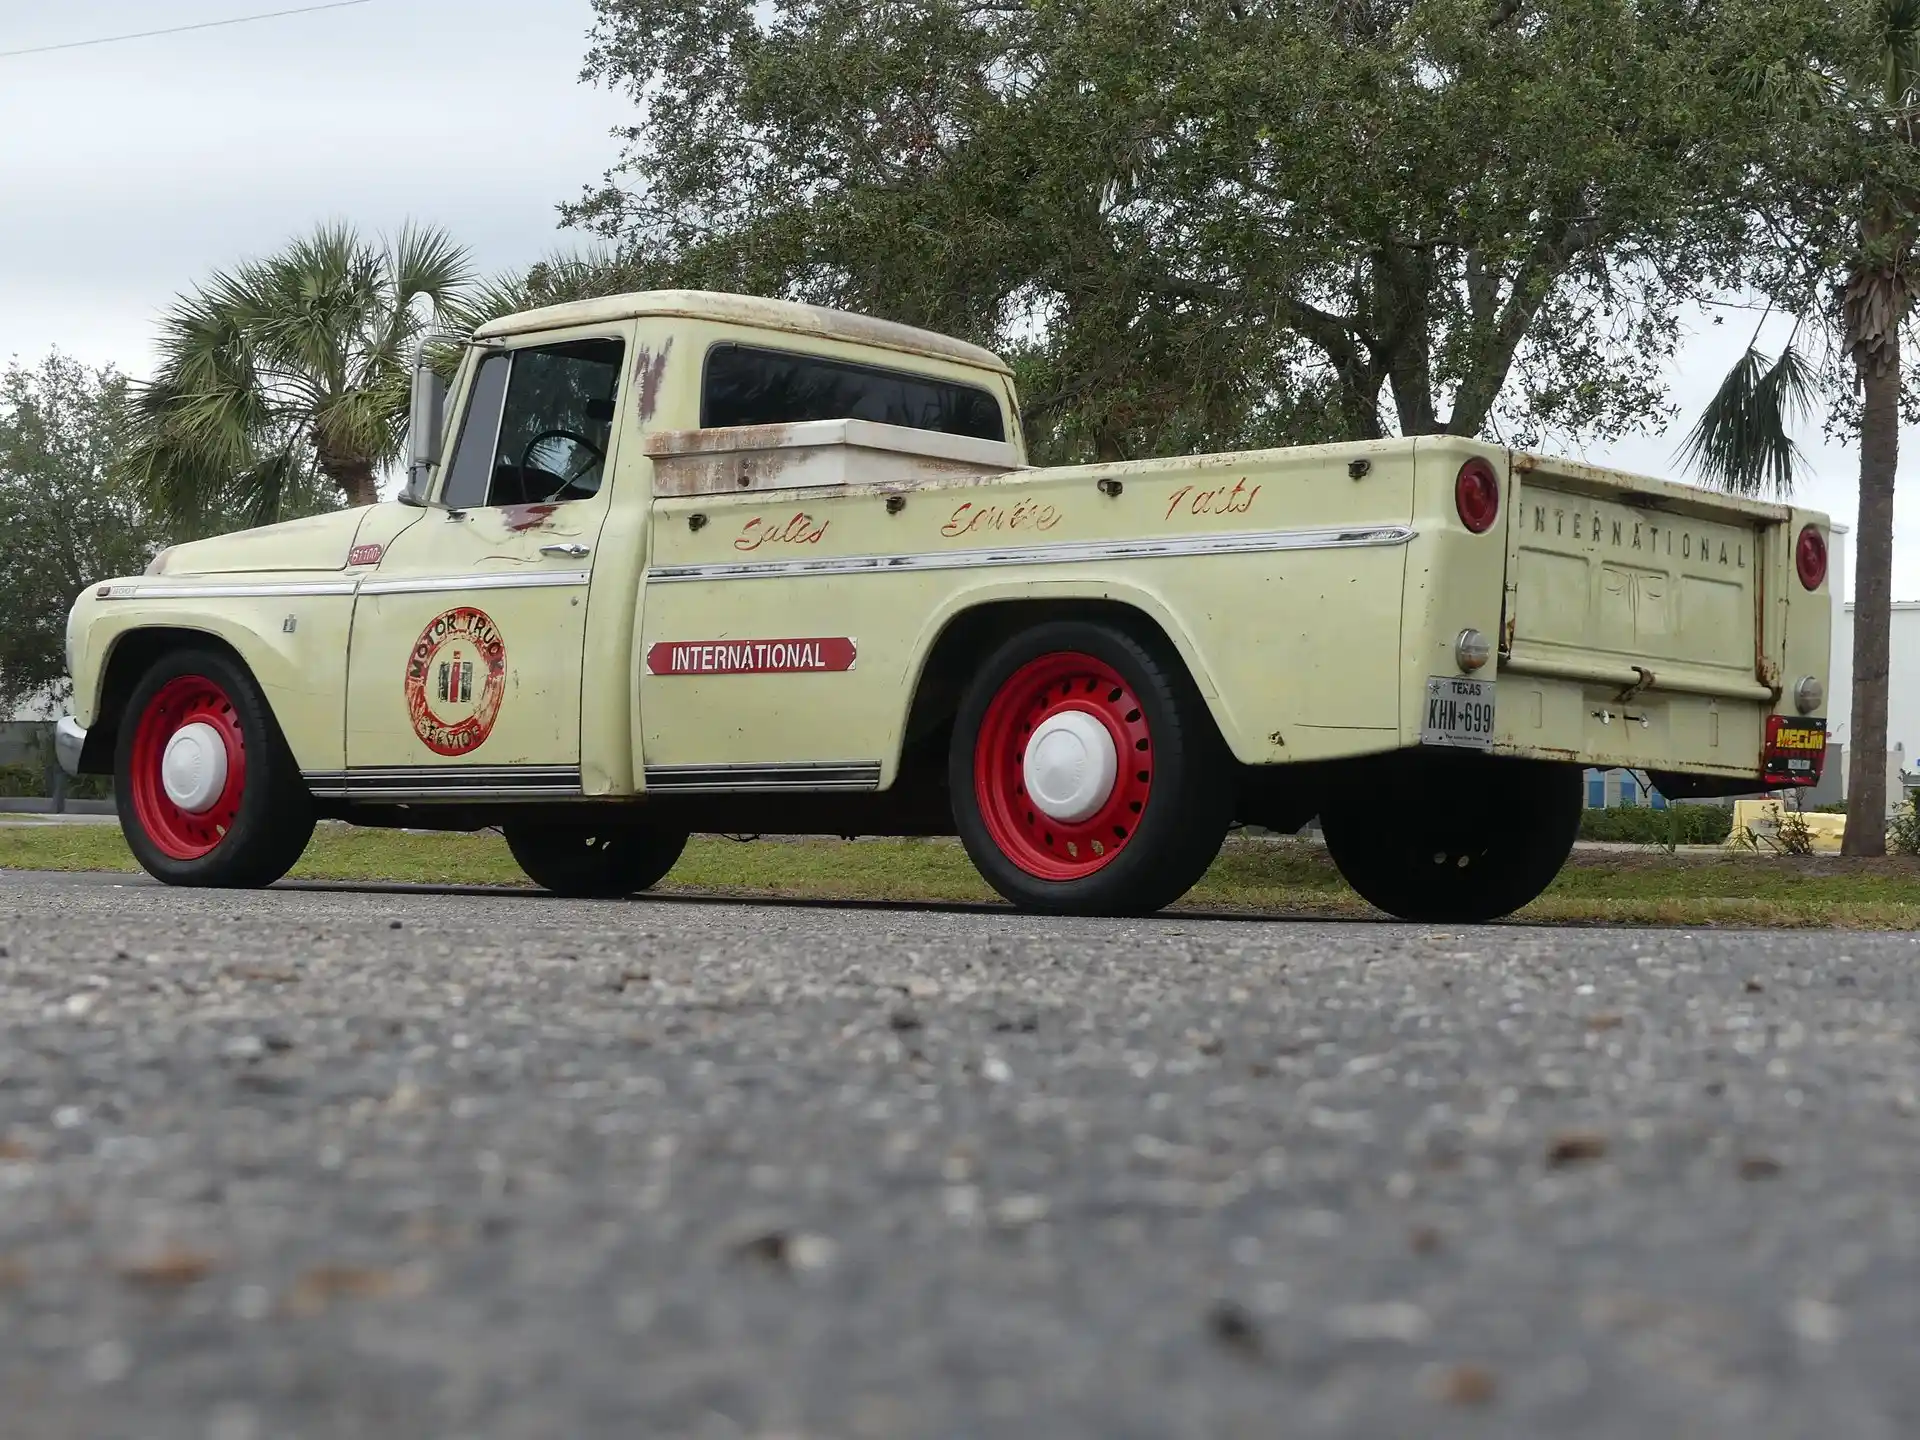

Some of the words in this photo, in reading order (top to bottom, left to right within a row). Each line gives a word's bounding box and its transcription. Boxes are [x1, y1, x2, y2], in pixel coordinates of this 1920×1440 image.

[733, 512, 831, 551] Sales
[1518, 502, 1746, 569] INTERNATIONAL
[409, 613, 457, 678] MOTOR
[671, 642, 826, 671] INTERNATIONAL
[1451, 681, 1482, 696] TEXAS
[1776, 728, 1824, 750] MECUM
